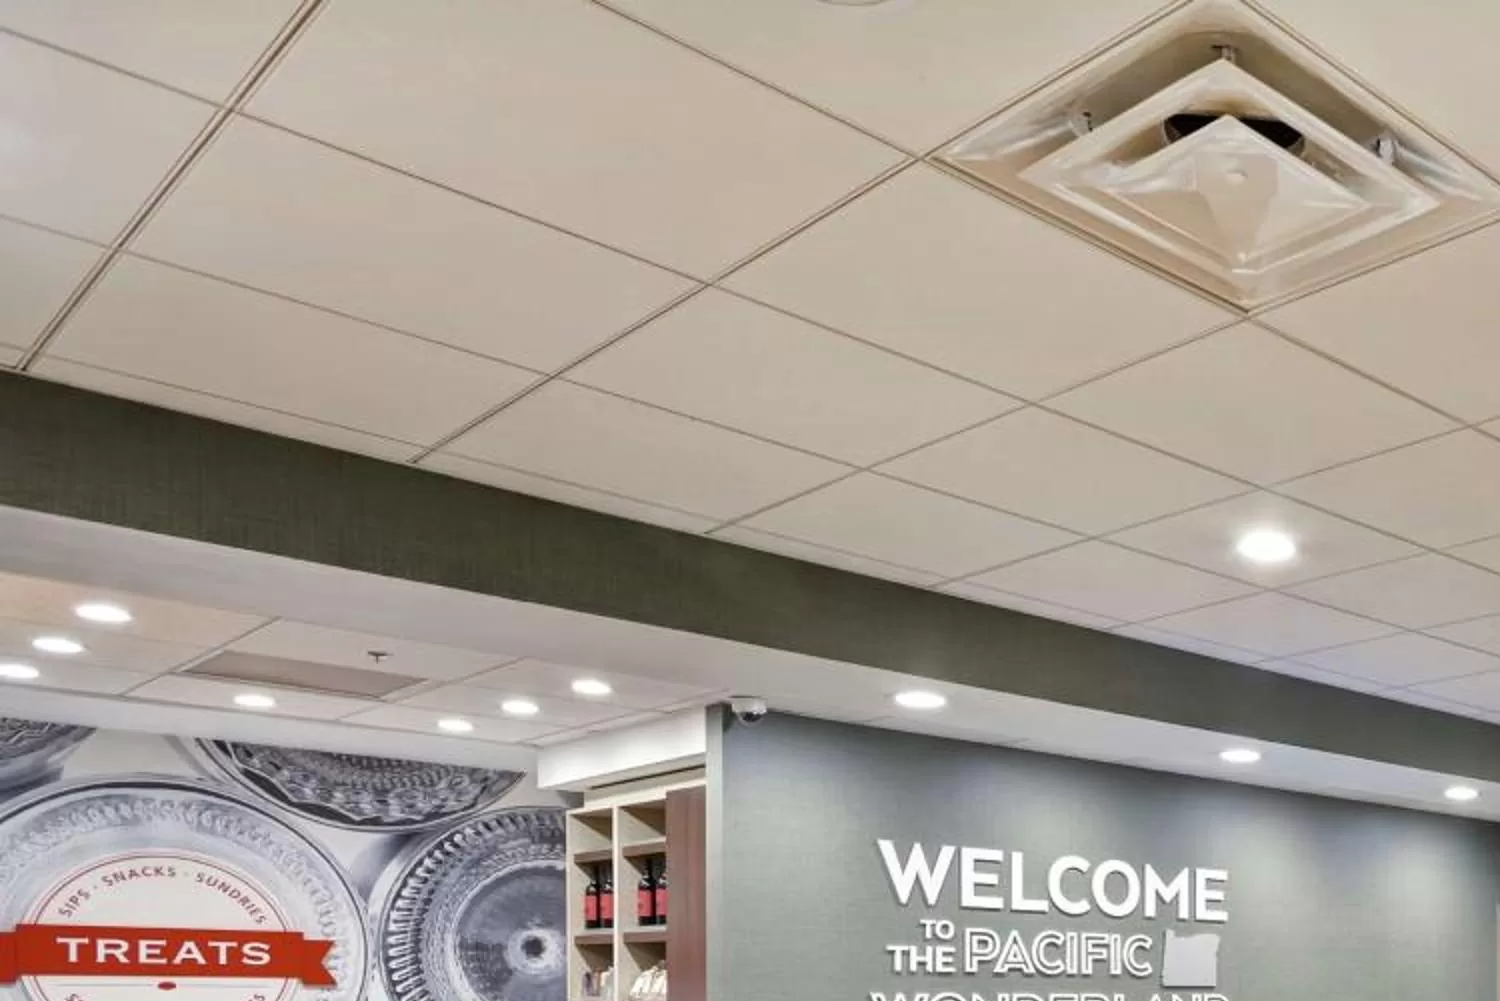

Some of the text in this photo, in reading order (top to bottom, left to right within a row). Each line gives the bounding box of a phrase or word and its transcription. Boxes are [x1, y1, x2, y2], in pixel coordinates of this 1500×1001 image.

[58, 865, 268, 925] SIPS SNACKS SUNDRIES
[877, 838, 1230, 923] WELCOME
[56, 936, 273, 967] TREATS
[885, 927, 1154, 977] THE PACIFIC
[919, 918, 955, 941] TO
